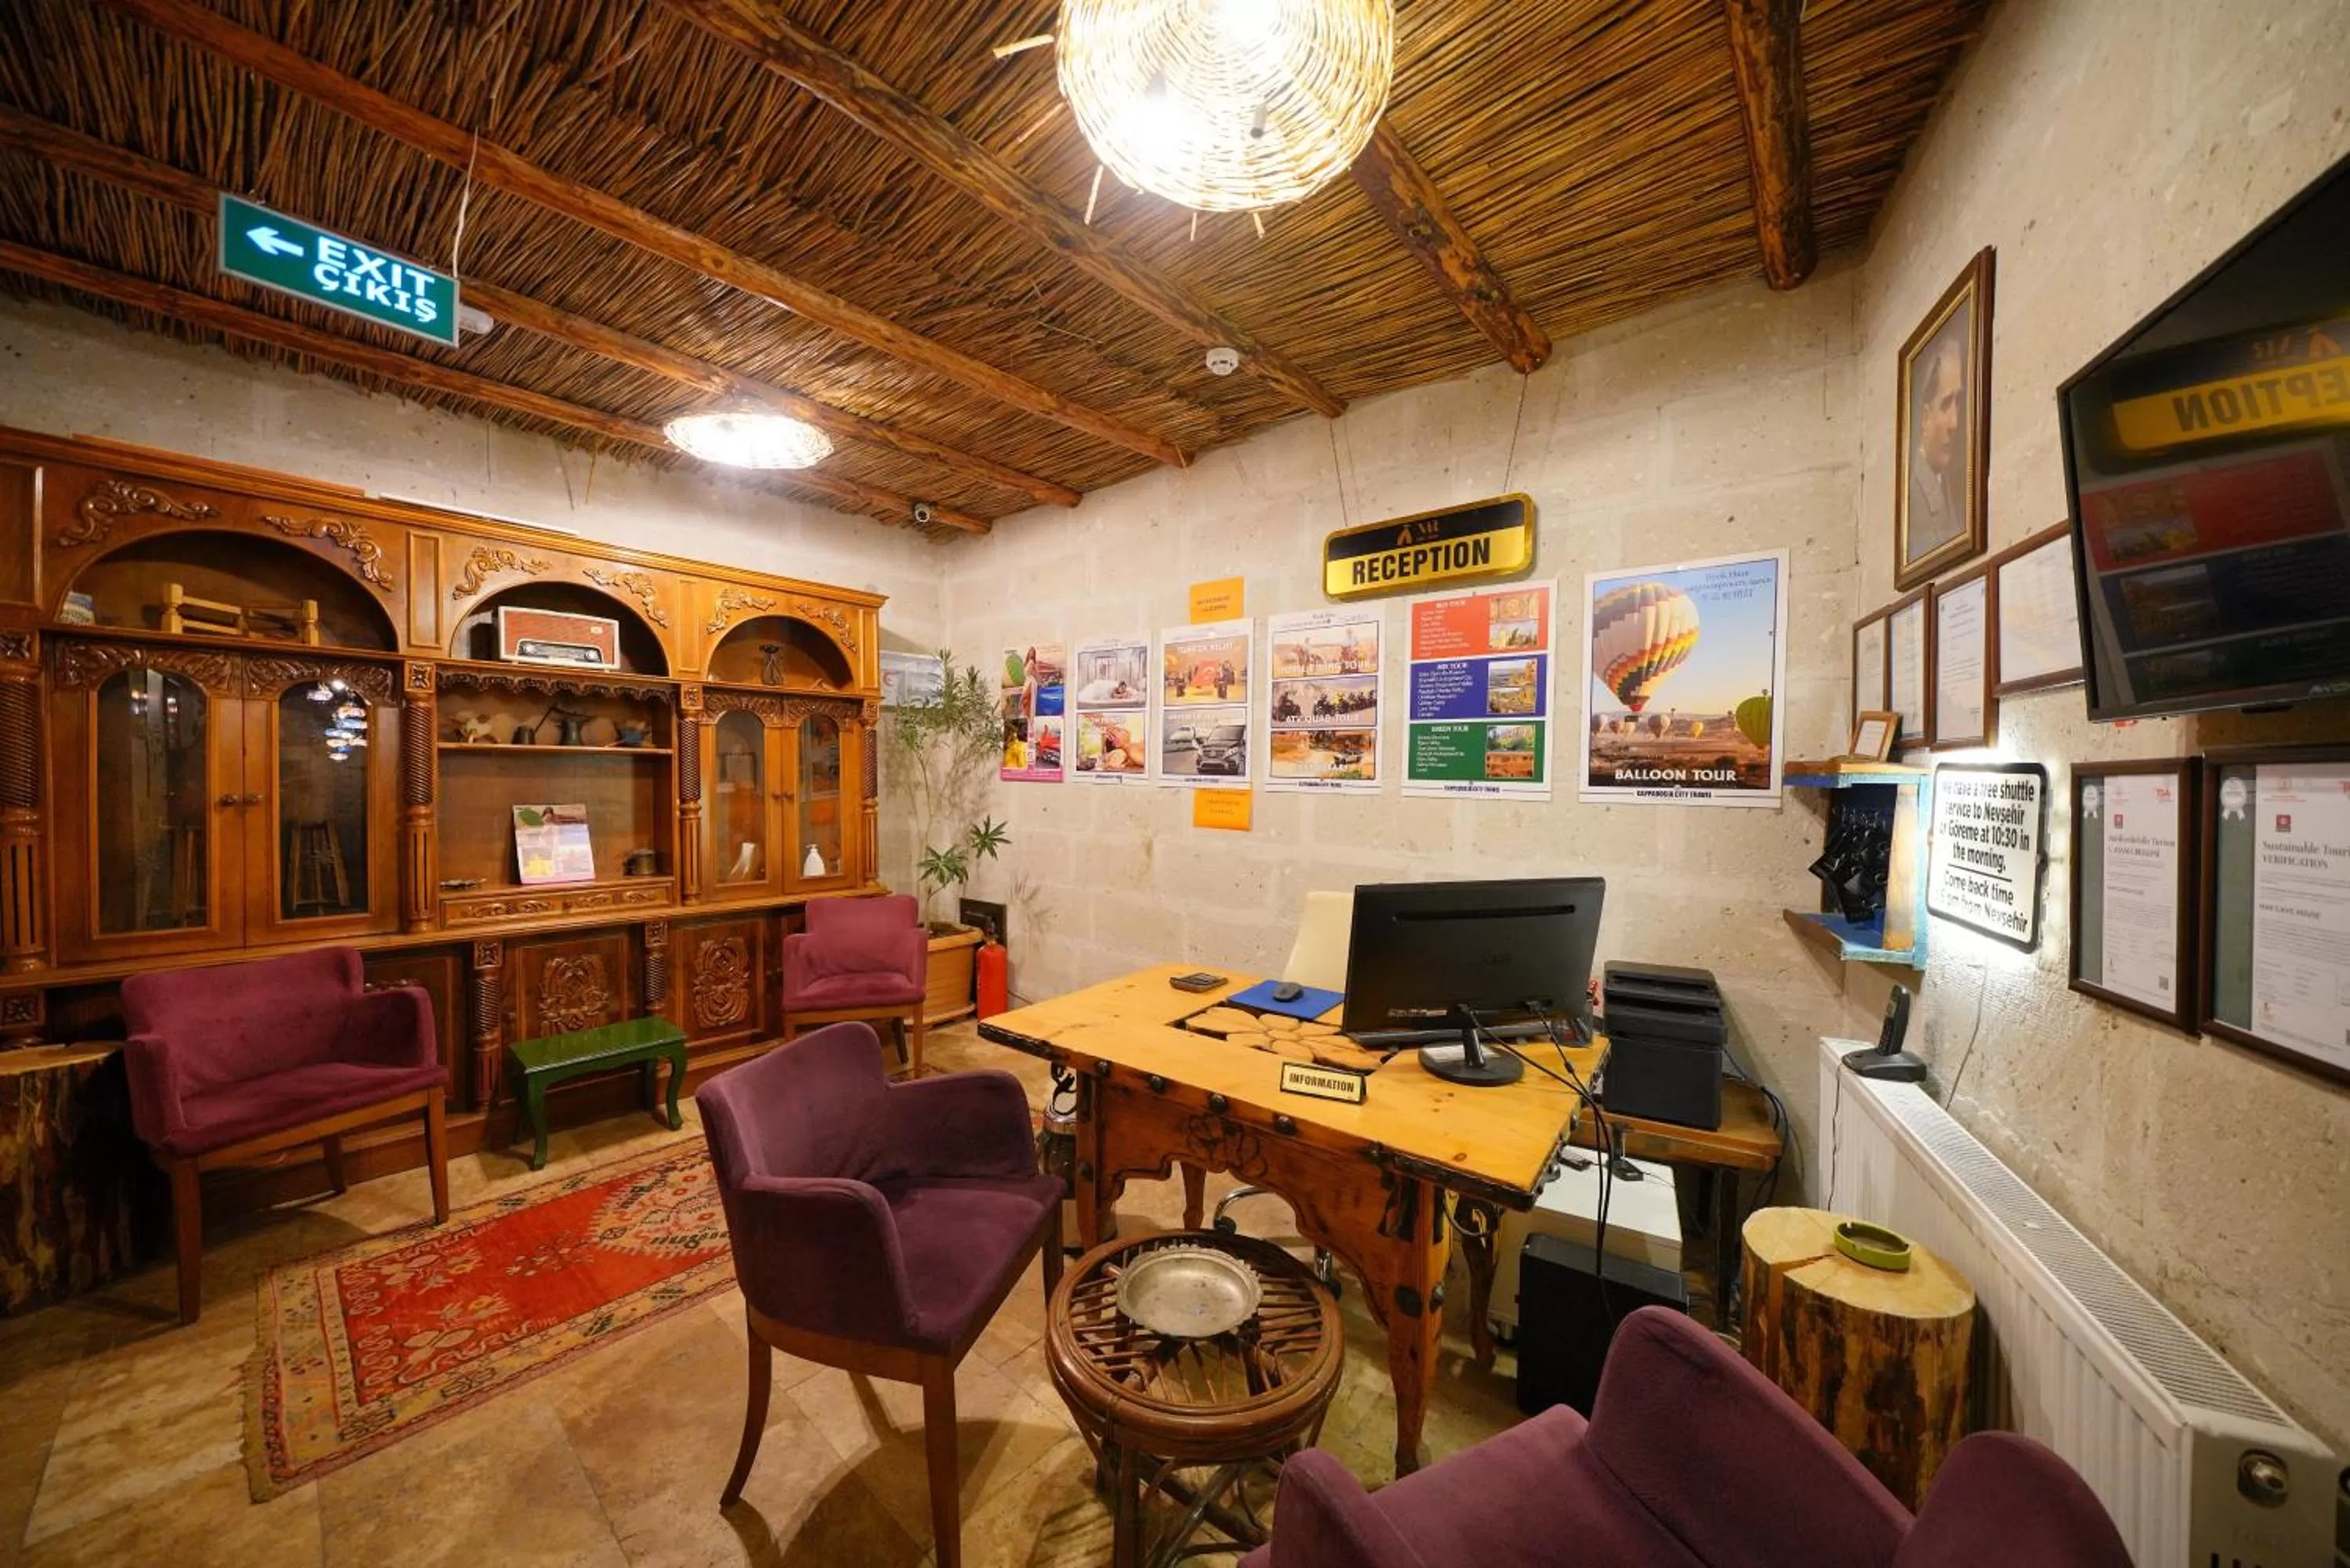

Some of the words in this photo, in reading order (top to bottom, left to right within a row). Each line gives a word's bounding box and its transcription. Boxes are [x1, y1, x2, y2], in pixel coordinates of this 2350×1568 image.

[318, 237, 435, 297] EXIT
[313, 263, 438, 322] ÇIKIŞ
[1353, 537, 1491, 585] RECEPTION
[1614, 768, 1687, 781] BALLOON
[1692, 769, 1737, 782] TOUR
[2000, 778, 2035, 802] shuttle
[1973, 801, 1983, 820] to
[1980, 826, 1990, 844] at
[1992, 826, 2018, 848] 10:30
[2020, 829, 2030, 851] in
[1953, 840, 1965, 861] the
[1967, 846, 2007, 873] morning.
[1944, 870, 1966, 891] Come
[1968, 876, 1990, 898] back
[1991, 882, 2015, 906] time
[1289, 1072, 1354, 1093] INFORMATION
